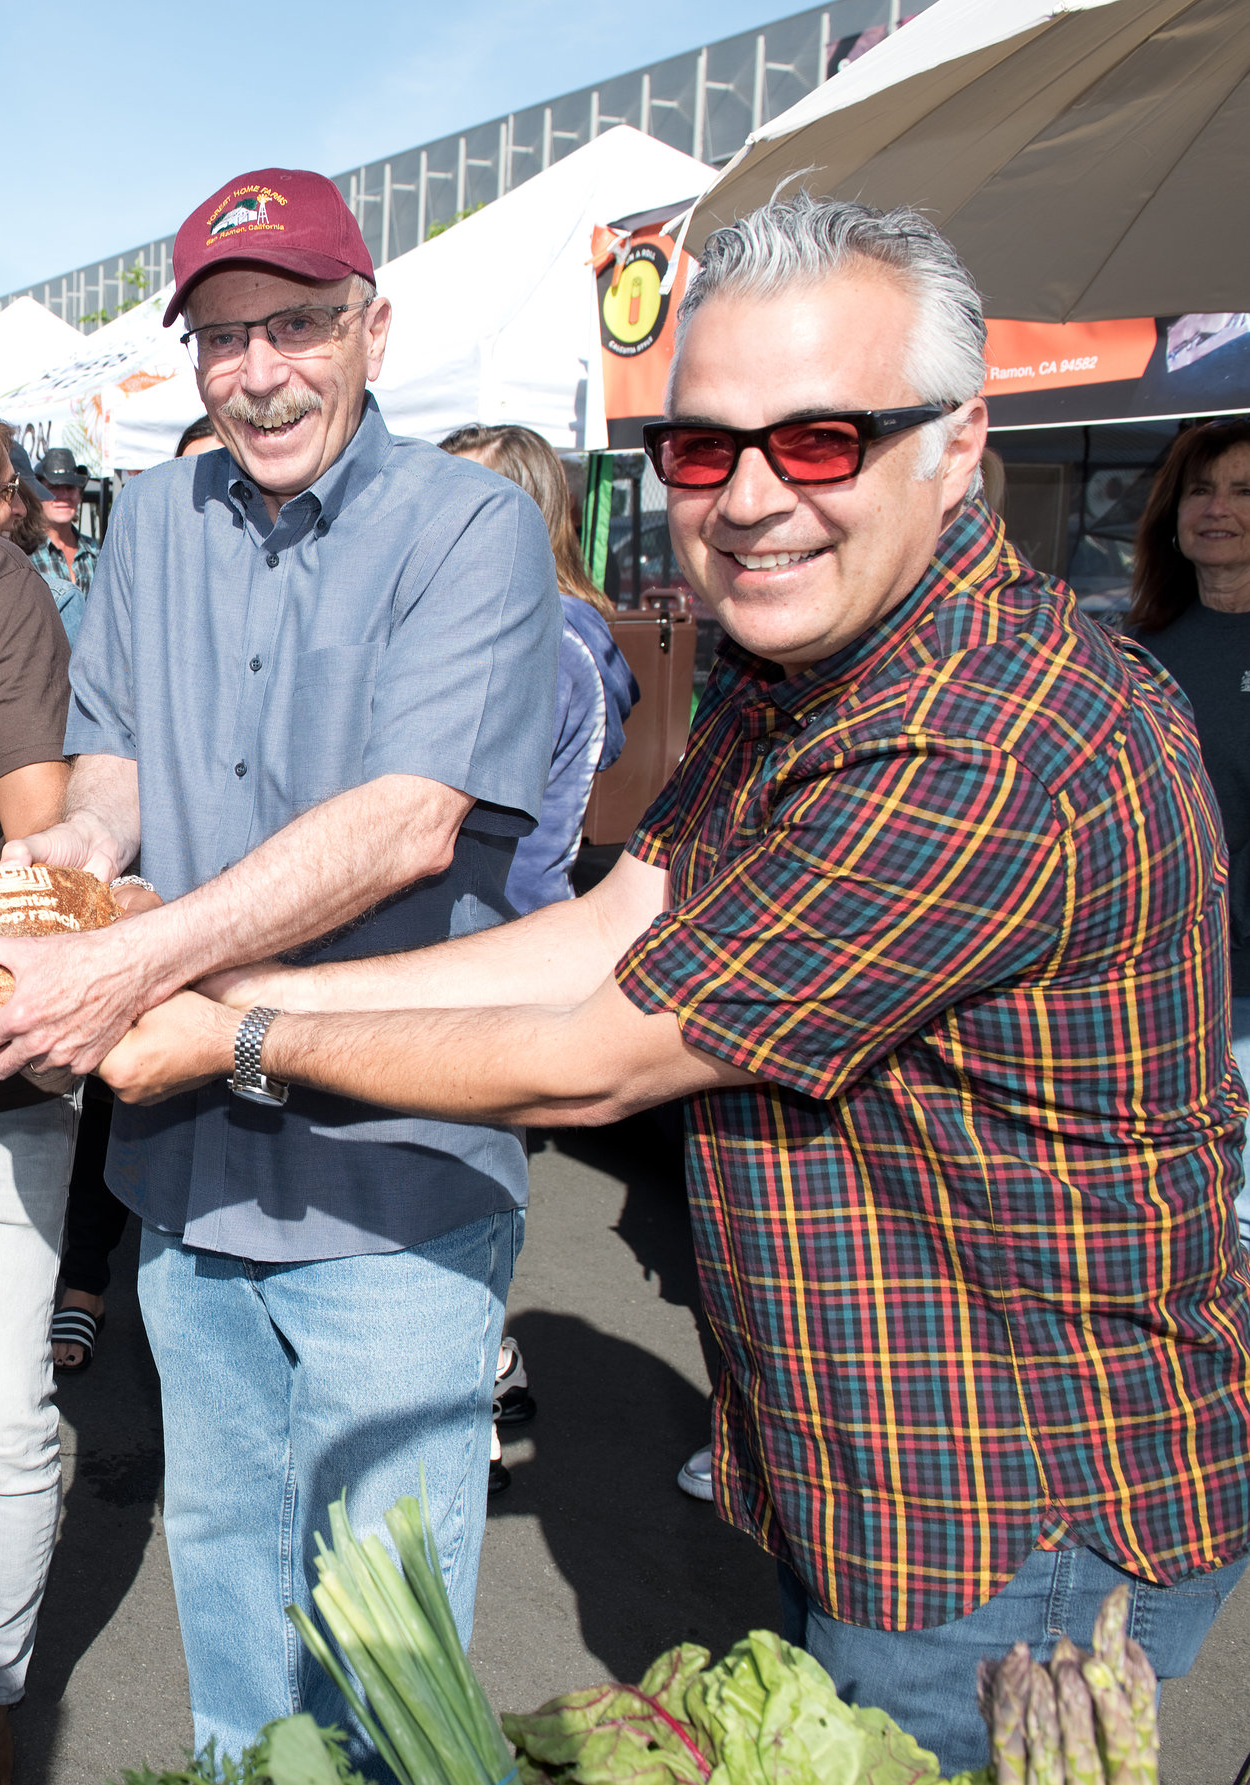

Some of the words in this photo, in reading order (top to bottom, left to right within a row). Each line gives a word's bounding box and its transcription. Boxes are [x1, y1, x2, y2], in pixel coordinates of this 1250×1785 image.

[233, 185, 260, 197] HOME
[260, 187, 288, 206] FARMS
[219, 227, 247, 239] Ramon,
[248, 223, 285, 231] California
[990, 366, 1036, 380] Ramon,
[1038, 360, 1057, 375] CA
[1060, 356, 1098, 373] 94582
[29, 910, 80, 930] ranch
